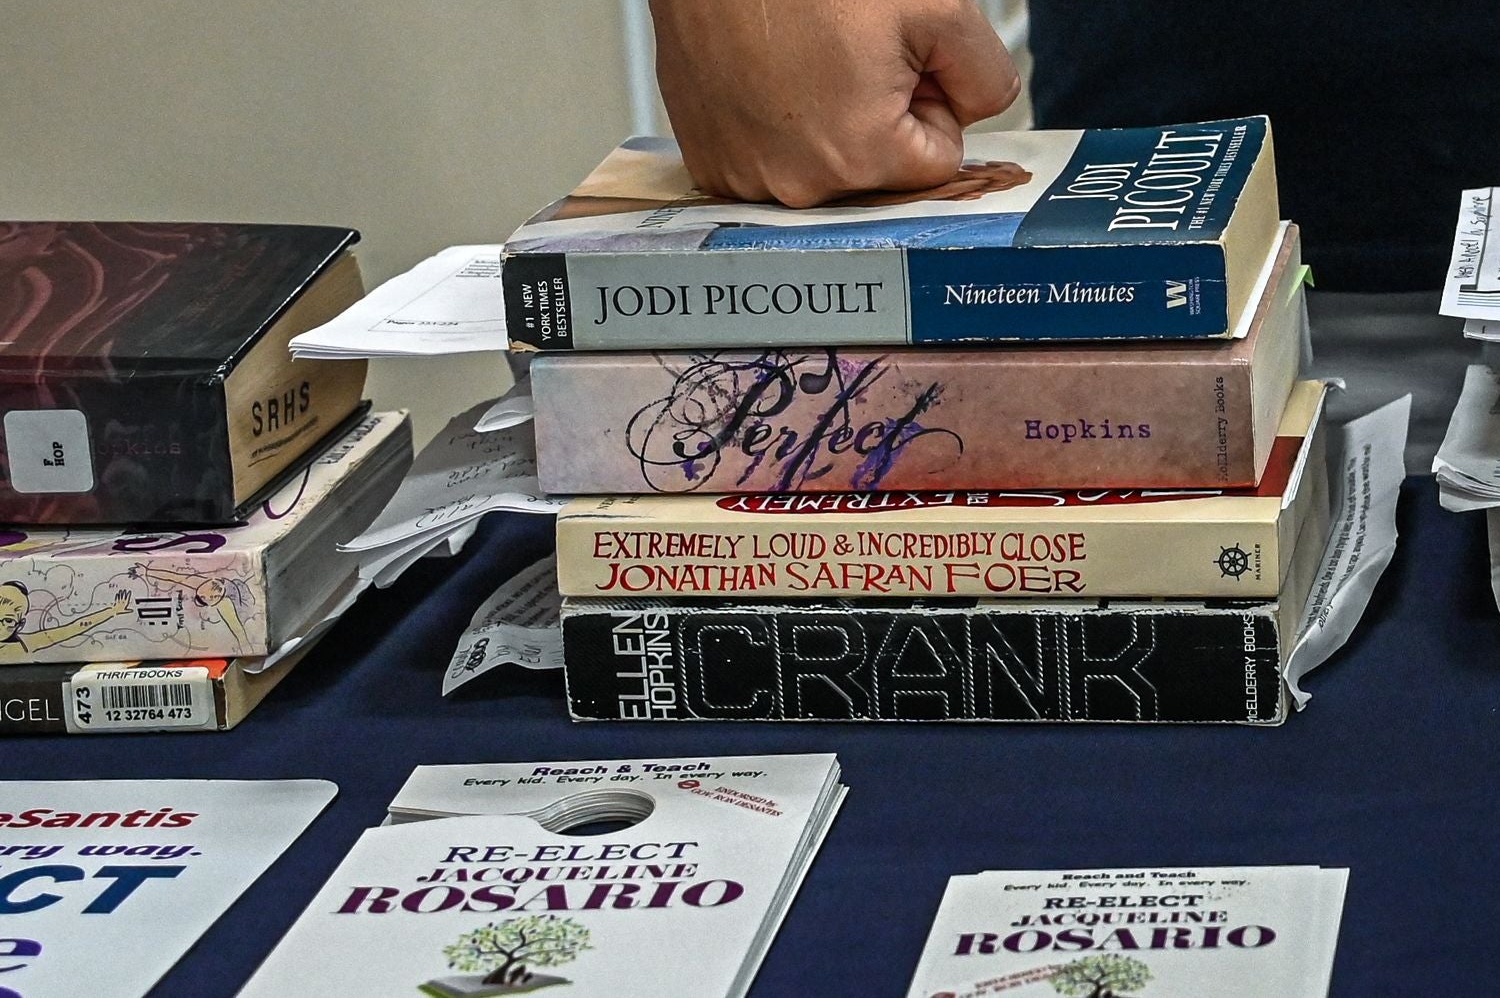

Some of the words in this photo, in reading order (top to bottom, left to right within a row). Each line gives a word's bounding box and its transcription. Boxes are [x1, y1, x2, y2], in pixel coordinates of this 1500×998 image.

[1049, 161, 1138, 201] JODI
[1107, 131, 1223, 231] PICOULT
[1189, 215, 1205, 230] THE
[1223, 125, 1247, 161] BESTSELLER
[523, 284, 533, 309] NEW
[541, 280, 550, 309] TIMES
[553, 277, 567, 338] BESTSELLER
[595, 285, 690, 325] JODI
[703, 281, 883, 315] PICOULT
[944, 284, 1041, 306] Nineteen
[1046, 281, 1135, 304] Minutes
[526, 317, 535, 328] #1
[542, 310, 551, 341] YORK
[1216, 376, 1229, 411] Books
[252, 381, 311, 437] SRHS
[636, 350, 963, 490] Perfect
[1024, 420, 1152, 441] Hopkins
[43, 458, 53, 467] F
[53, 441, 65, 467] HOP
[593, 531, 745, 560] EXTREMELY
[753, 533, 827, 559] LOUD
[834, 534, 855, 556] &
[858, 531, 997, 559] INCREDIBLY
[1001, 532, 1087, 562] CLOSE
[595, 562, 776, 592] JONATHAN
[787, 562, 933, 593] SAFRAN
[946, 563, 1087, 593] FOER
[1243, 610, 1256, 652] BOOKS
[96, 669, 184, 681] THRIFTBOOKS
[611, 611, 651, 720] ELLEN
[644, 613, 676, 720] HOPKINS
[678, 613, 1158, 720] CRANK
[76, 686, 91, 724] 473
[106, 709, 121, 721] 12
[125, 708, 164, 721] 32764
[168, 707, 192, 720] 473
[463, 777, 512, 787] Every
[517, 775, 547, 786] kid.
[556, 775, 604, 785] Every
[610, 773, 645, 783] day.
[653, 772, 673, 781] In
[679, 770, 725, 781] every
[731, 770, 768, 780] way.
[532, 764, 609, 776] Reach
[616, 763, 633, 774] &
[641, 762, 711, 773] Teach
[78, 844, 203, 859] way.
[440, 841, 699, 863] RE-ELECT
[416, 863, 698, 886] JACQUELINE
[1004, 883, 1042, 892] Every
[1079, 881, 1116, 889] Every
[1178, 879, 1215, 887] every
[1062, 872, 1110, 880] Reach
[1115, 871, 1145, 879] and
[1150, 870, 1196, 879] Teach
[334, 879, 745, 914] ROSARIO
[1042, 894, 1205, 910] RE-ELECT
[1011, 910, 1229, 927] JACQUELINE
[953, 924, 1278, 957] ROSARIO
